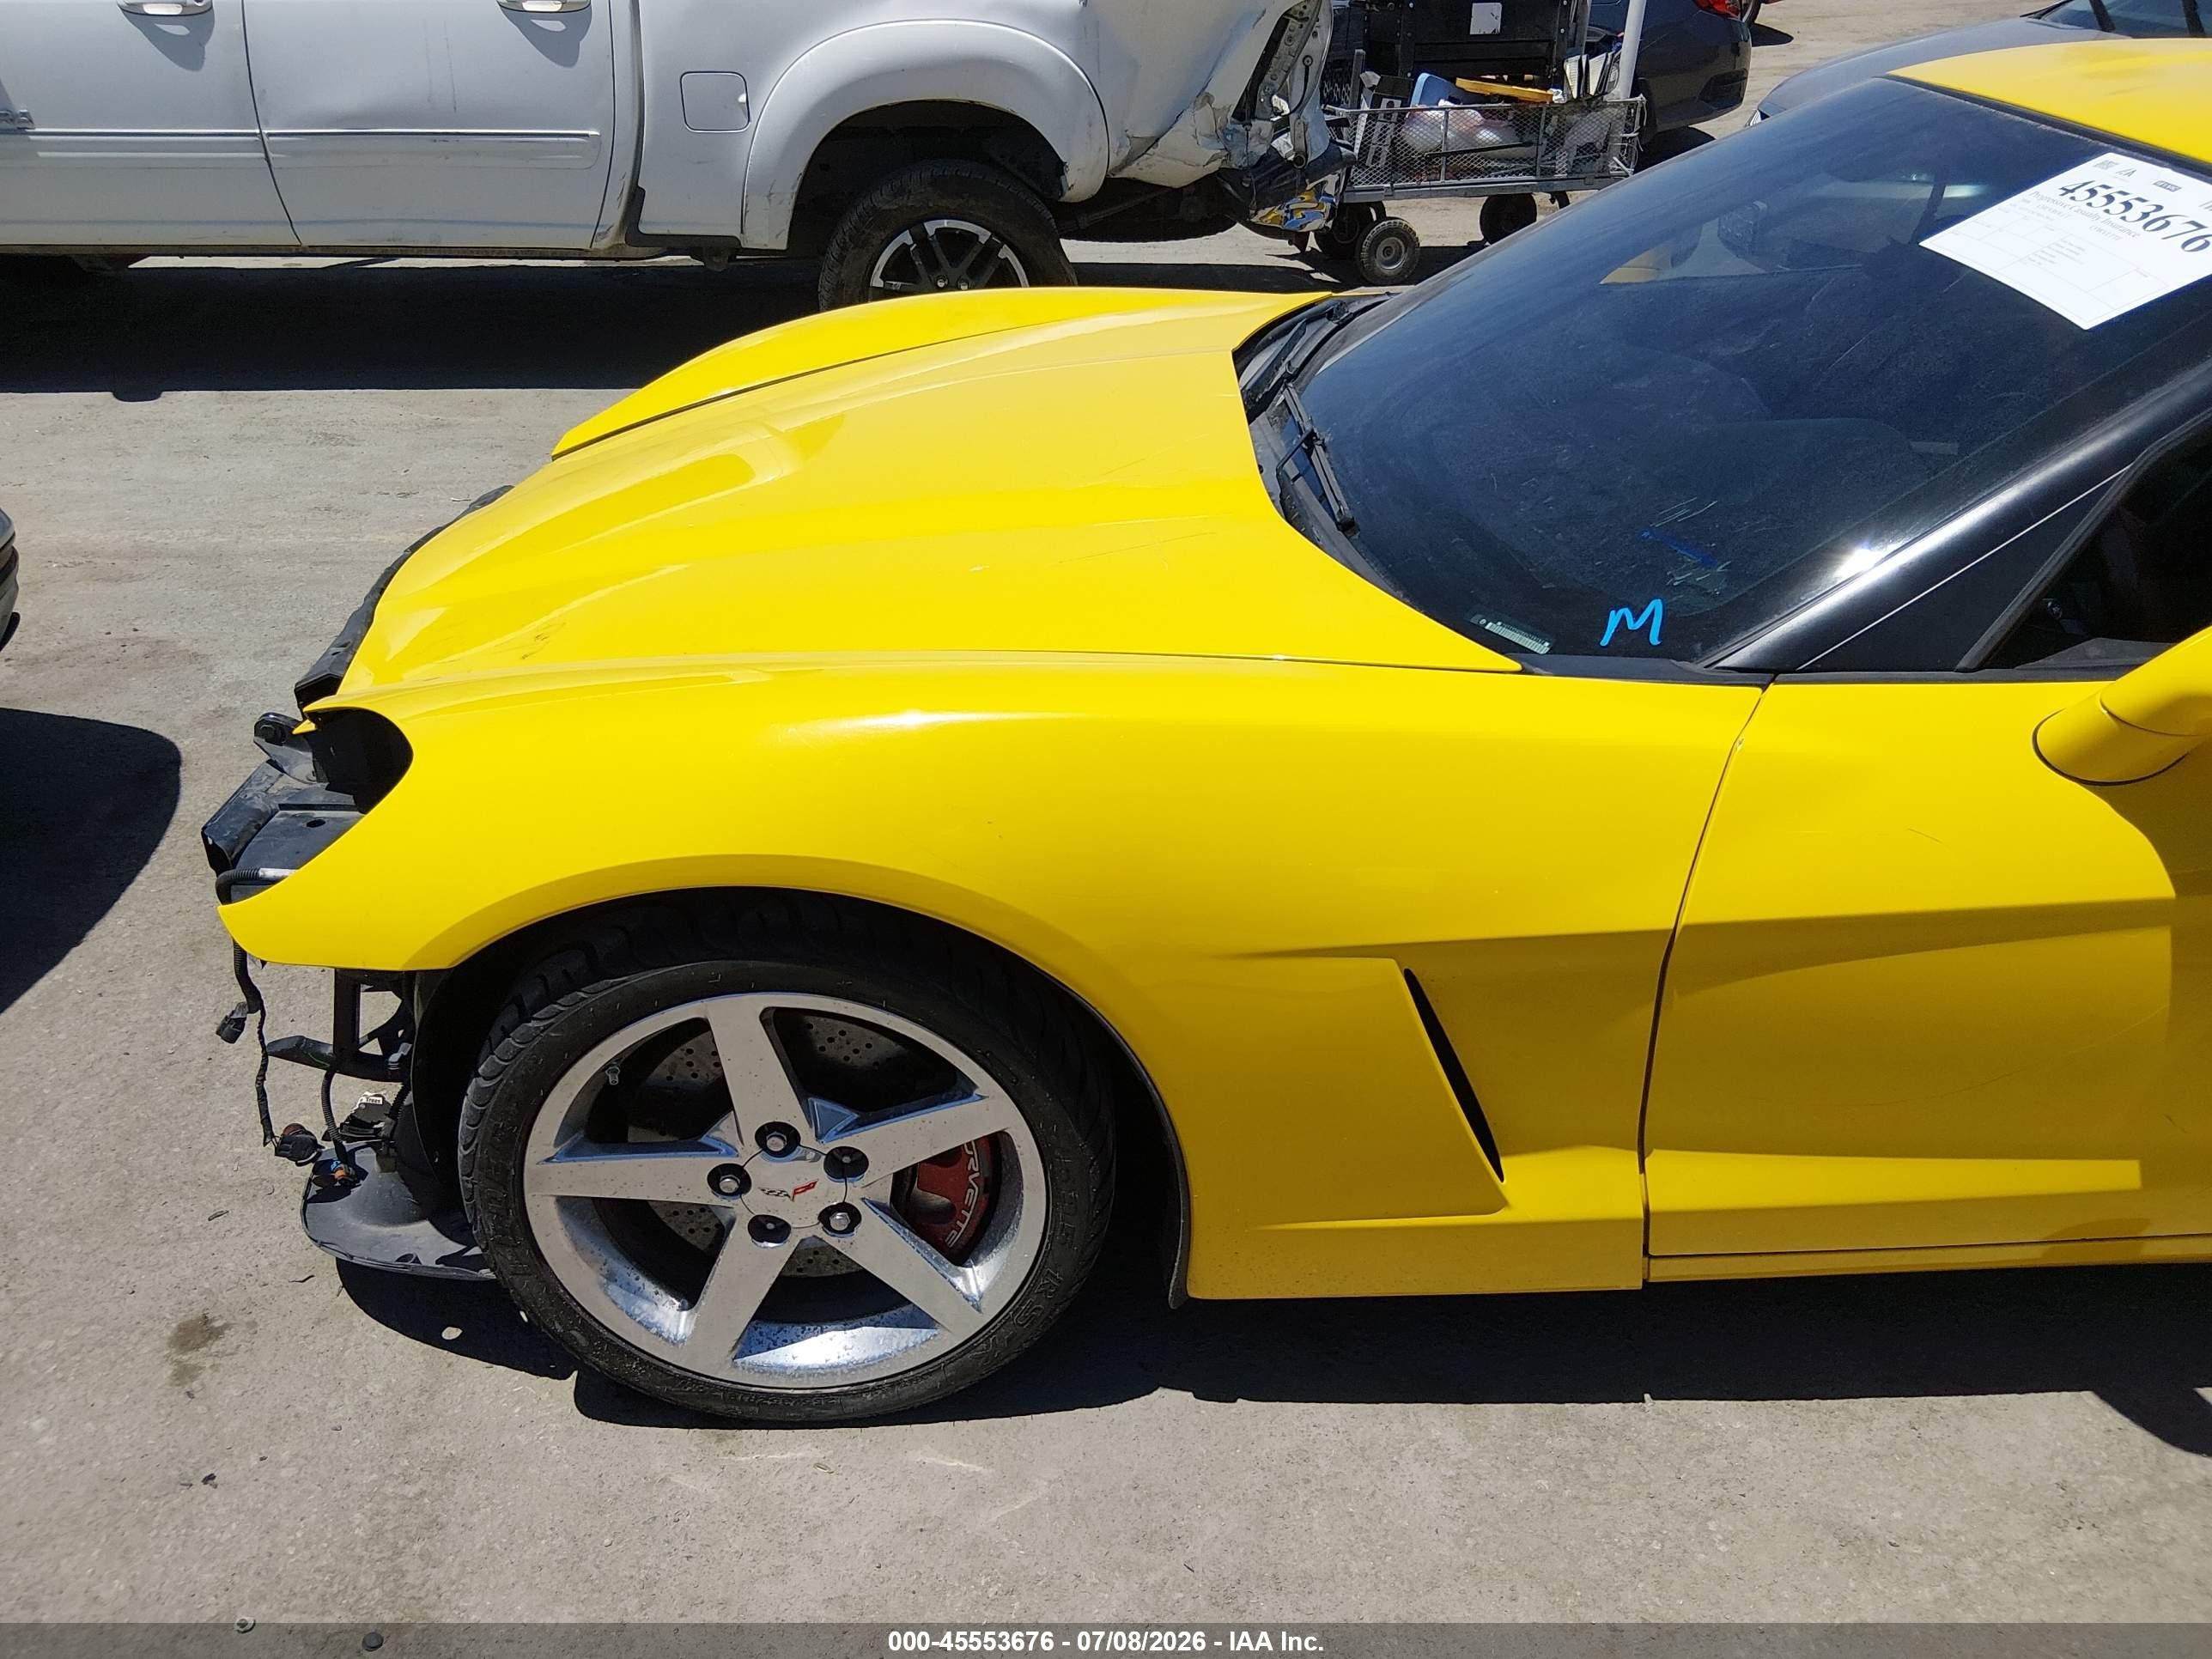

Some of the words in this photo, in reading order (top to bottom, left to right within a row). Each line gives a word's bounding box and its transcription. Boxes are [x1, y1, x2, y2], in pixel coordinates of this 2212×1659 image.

[2057, 179, 2212, 252] 45553676
[2101, 217, 2141, 238] Insurance
[1599, 599, 1663, 646] M
